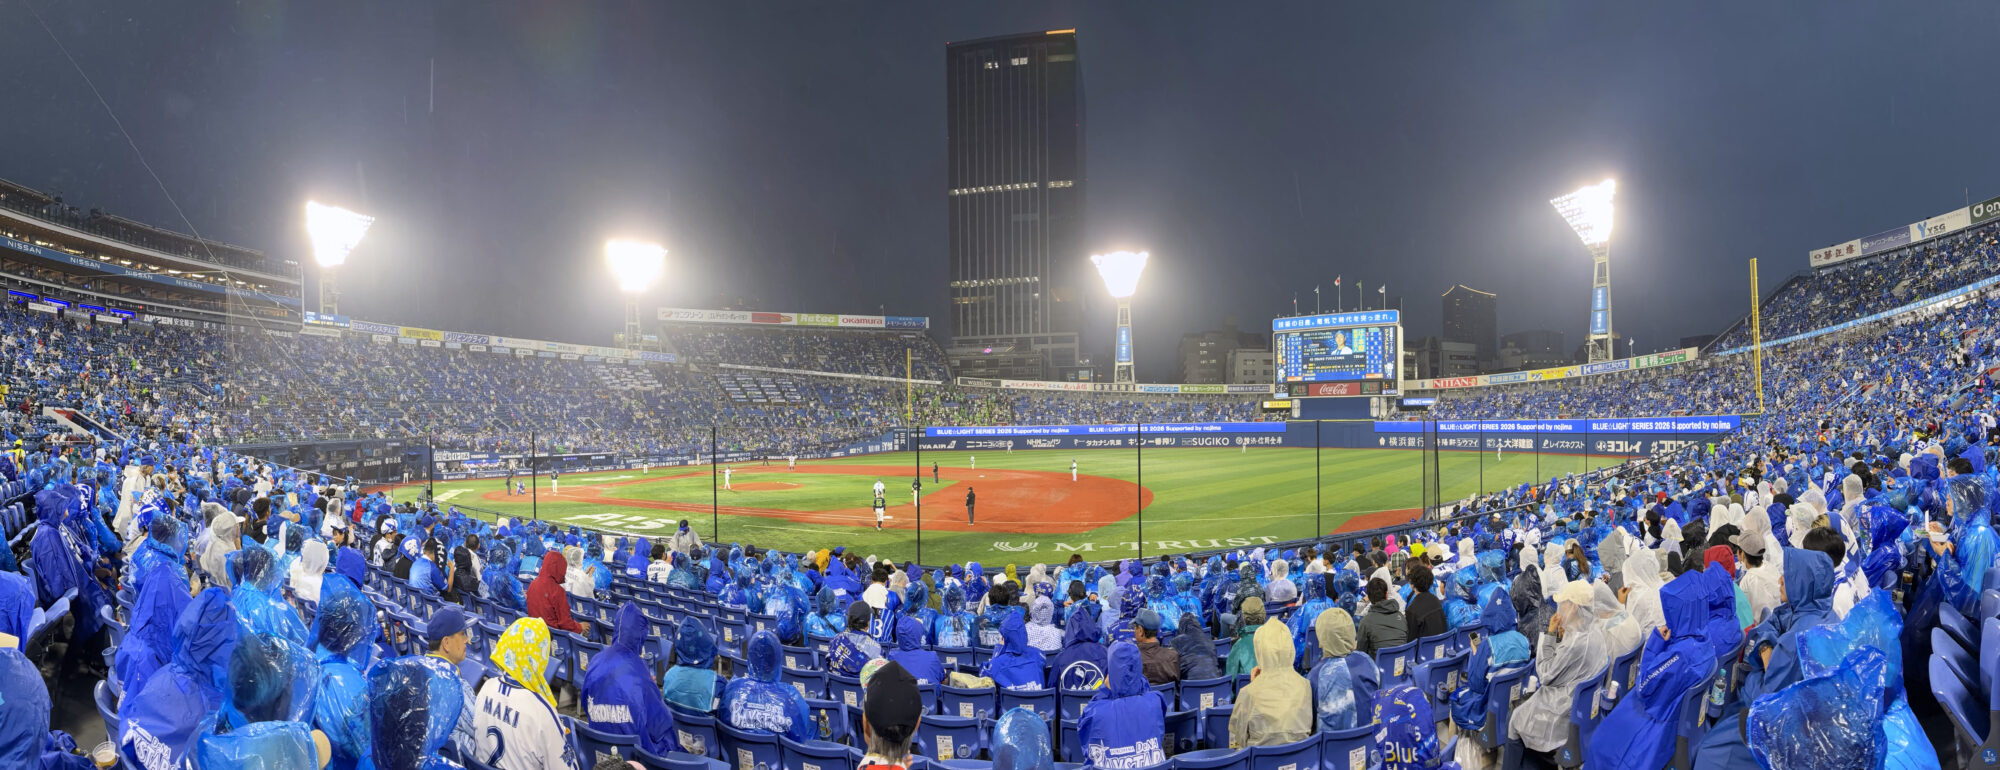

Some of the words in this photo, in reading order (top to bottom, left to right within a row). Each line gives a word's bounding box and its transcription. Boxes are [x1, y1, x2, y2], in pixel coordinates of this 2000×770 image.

[1926, 223, 1946, 234] YSG
[7, 239, 42, 255] NISSAN
[70, 257, 101, 269] NISSAN
[125, 269, 153, 280] NISSAN
[176, 279, 203, 289] NISSAN
[144, 314, 173, 325] ANZEN
[1516, 423, 1545, 431] Suppored
[1545, 423, 1553, 431] by
[1631, 422, 1654, 430] SERIES
[1654, 421, 1671, 430] 2026
[1702, 420, 1710, 431] by
[1192, 437, 1230, 446] SUGIKO
[1389, 437, 1425, 447] 横浜銀行
[1503, 438, 1534, 449] 大洋建設
[1549, 440, 1585, 448] レイズネクスト
[1606, 441, 1642, 453] ヨコレイ
[1053, 535, 1279, 552] M-TRUST
[483, 695, 521, 729] MAKI
[151, 736, 172, 759] DeNA
[485, 725, 507, 766] 2
[1135, 738, 1159, 754] DeNA
[1384, 741, 1419, 763] Blue
